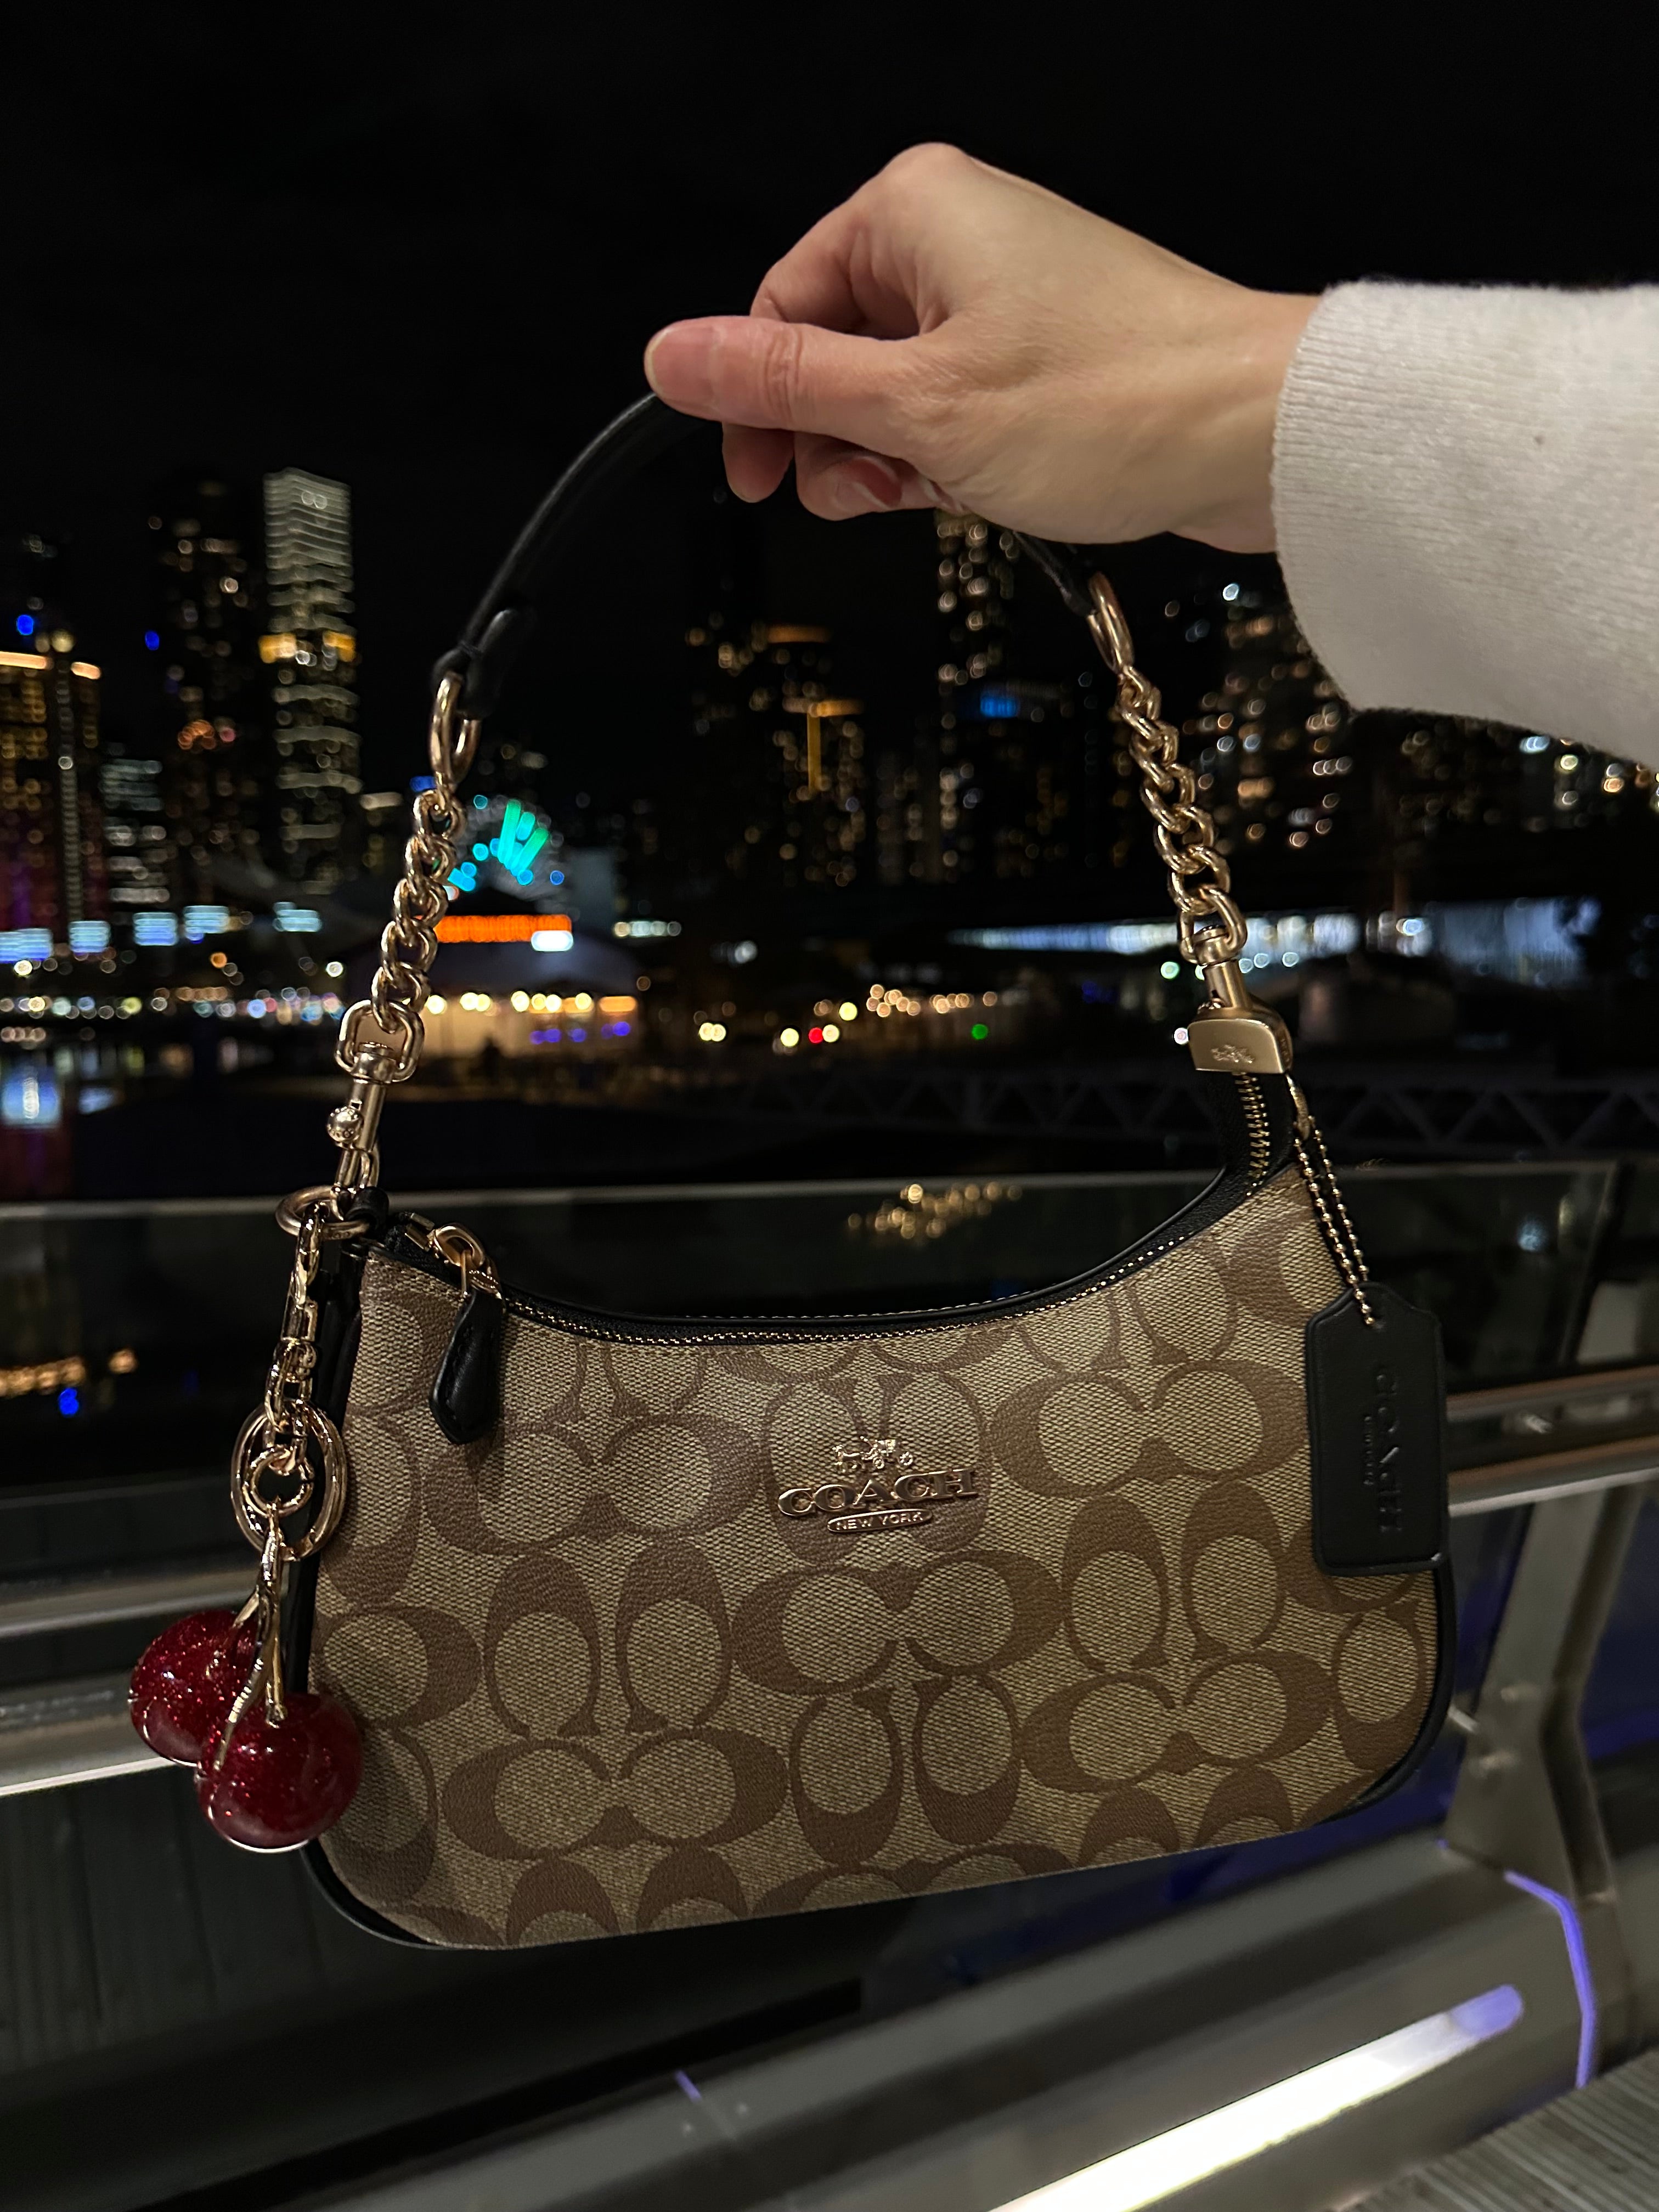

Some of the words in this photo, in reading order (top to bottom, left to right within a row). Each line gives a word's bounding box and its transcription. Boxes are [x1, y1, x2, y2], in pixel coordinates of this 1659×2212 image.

[777, 1468, 978, 1516] COACH
[836, 1519, 873, 1531] NEW
[878, 1511, 924, 1526] YORK
